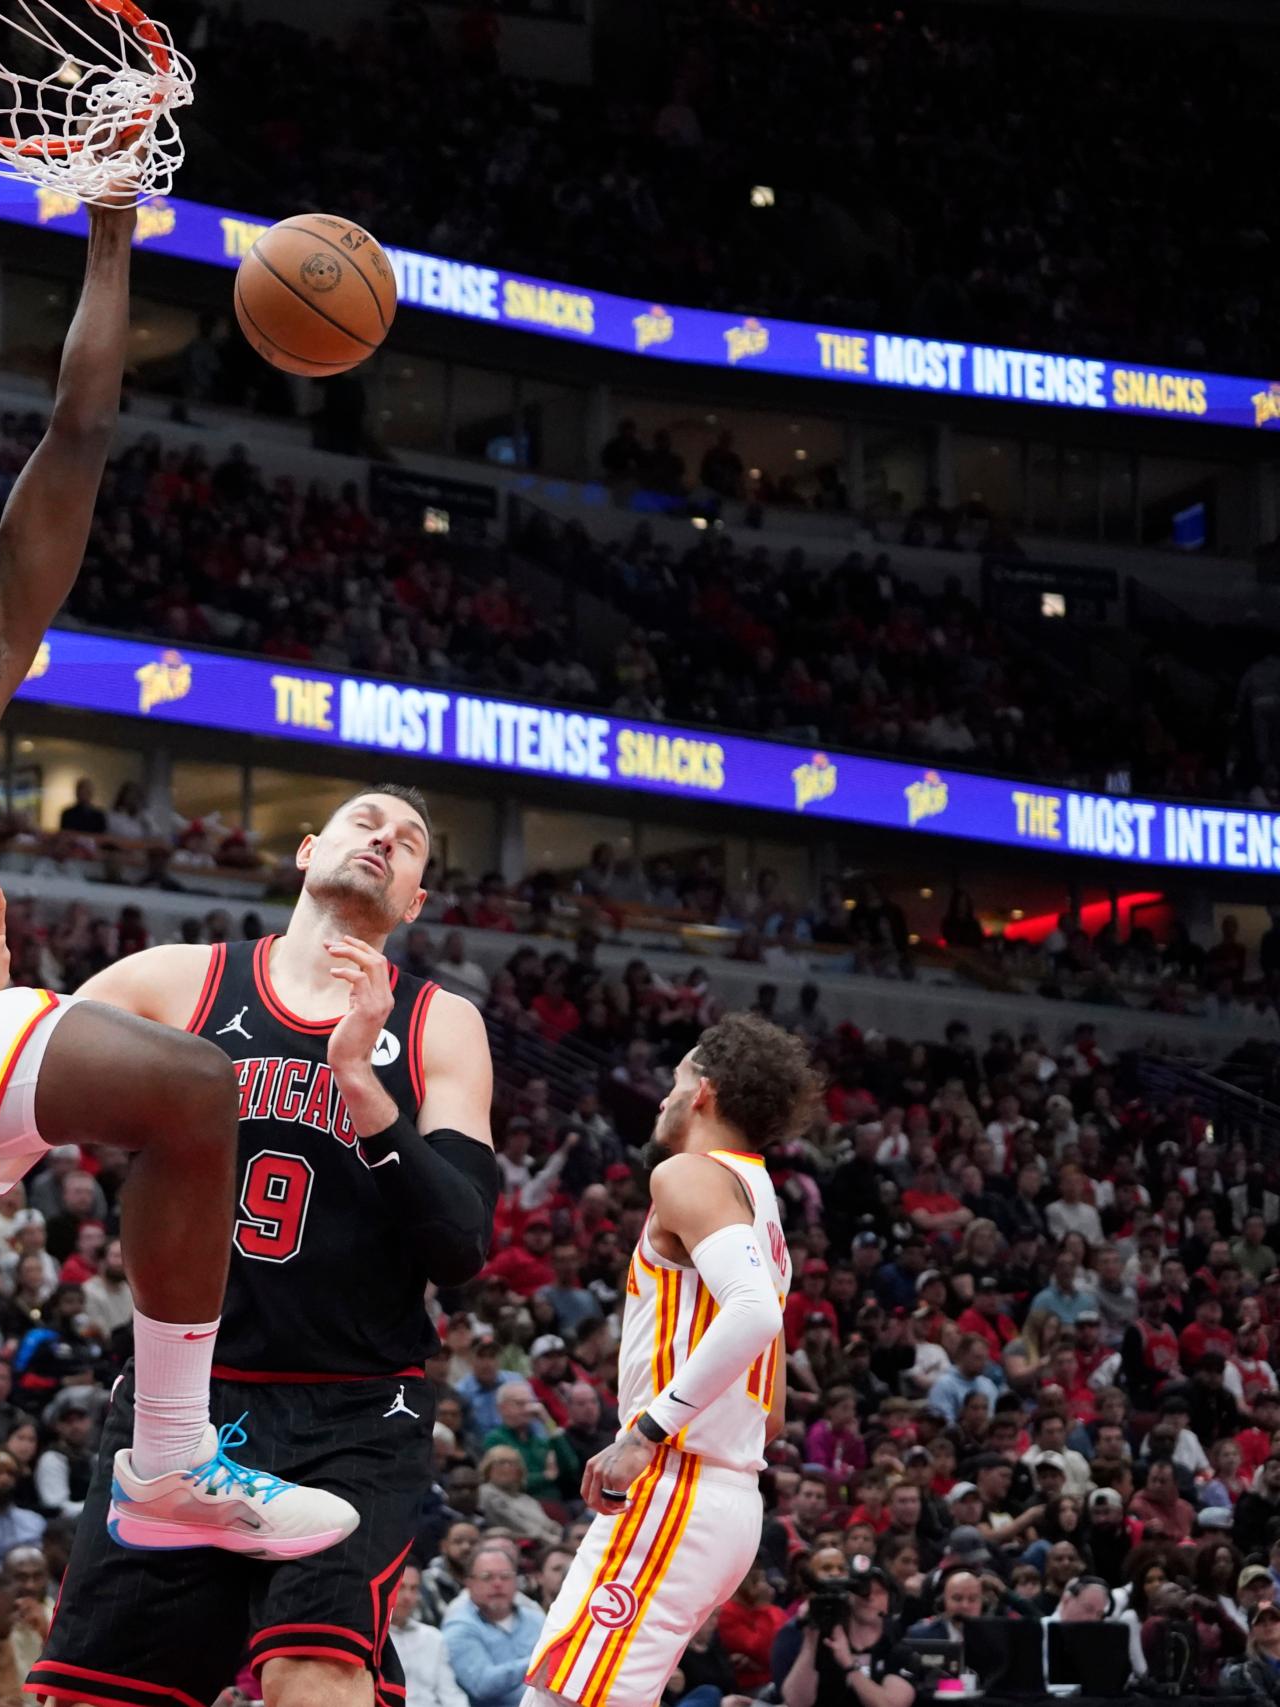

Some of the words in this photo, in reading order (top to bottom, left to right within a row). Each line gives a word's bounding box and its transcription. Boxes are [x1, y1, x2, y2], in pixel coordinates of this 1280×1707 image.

[503, 279, 594, 335] SNACKS
[816, 332, 868, 373] THE
[875, 334, 966, 391] MOST
[972, 346, 1107, 408] INTENSE
[1112, 368, 1207, 416] SNACKS
[271, 674, 333, 732] THE
[340, 679, 449, 755] MOST
[455, 697, 610, 780] INTENSE
[616, 729, 724, 791] SNACKS
[1013, 791, 1061, 839] THE
[1067, 793, 1156, 858] MOST
[233, 1150, 314, 1263] 9
